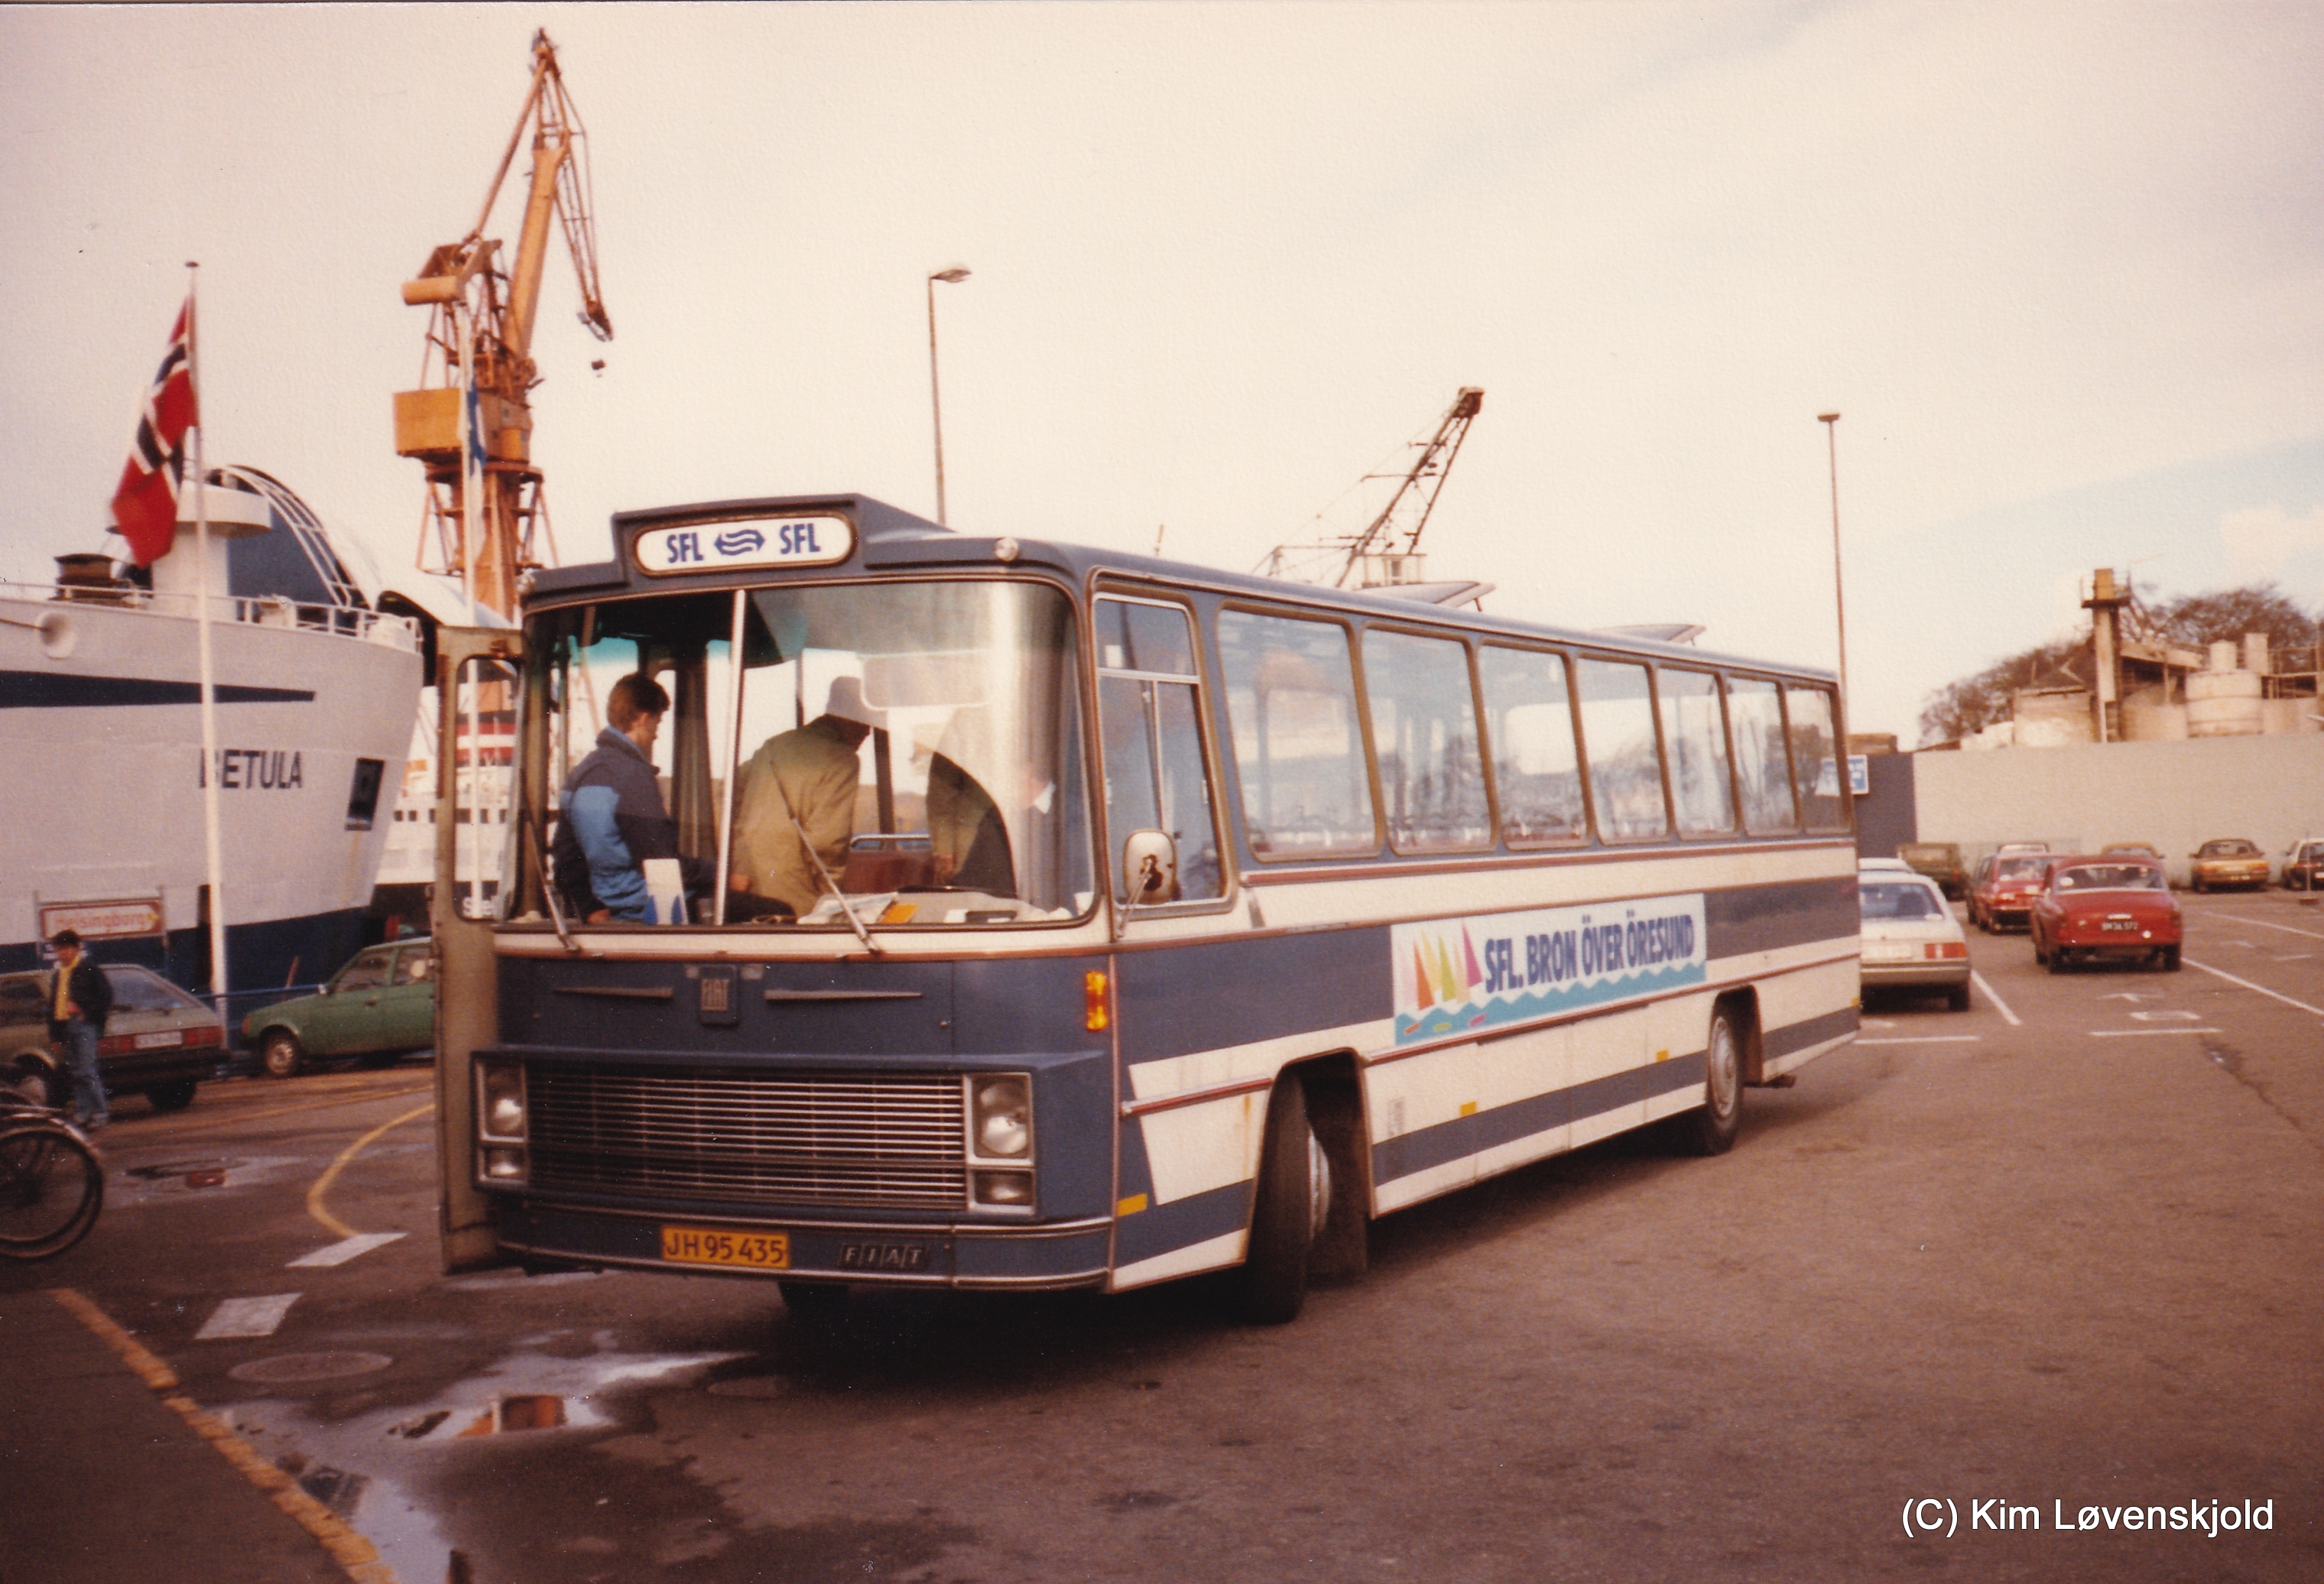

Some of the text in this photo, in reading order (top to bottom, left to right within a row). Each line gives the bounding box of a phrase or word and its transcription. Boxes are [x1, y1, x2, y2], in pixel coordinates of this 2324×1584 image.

[666, 523, 821, 563] SFL SFL
[1485, 910, 1695, 993] SFL. BRON ÖVER ÖRESUND
[738, 1237, 784, 1264] 435
[845, 1246, 923, 1265] FIAT
